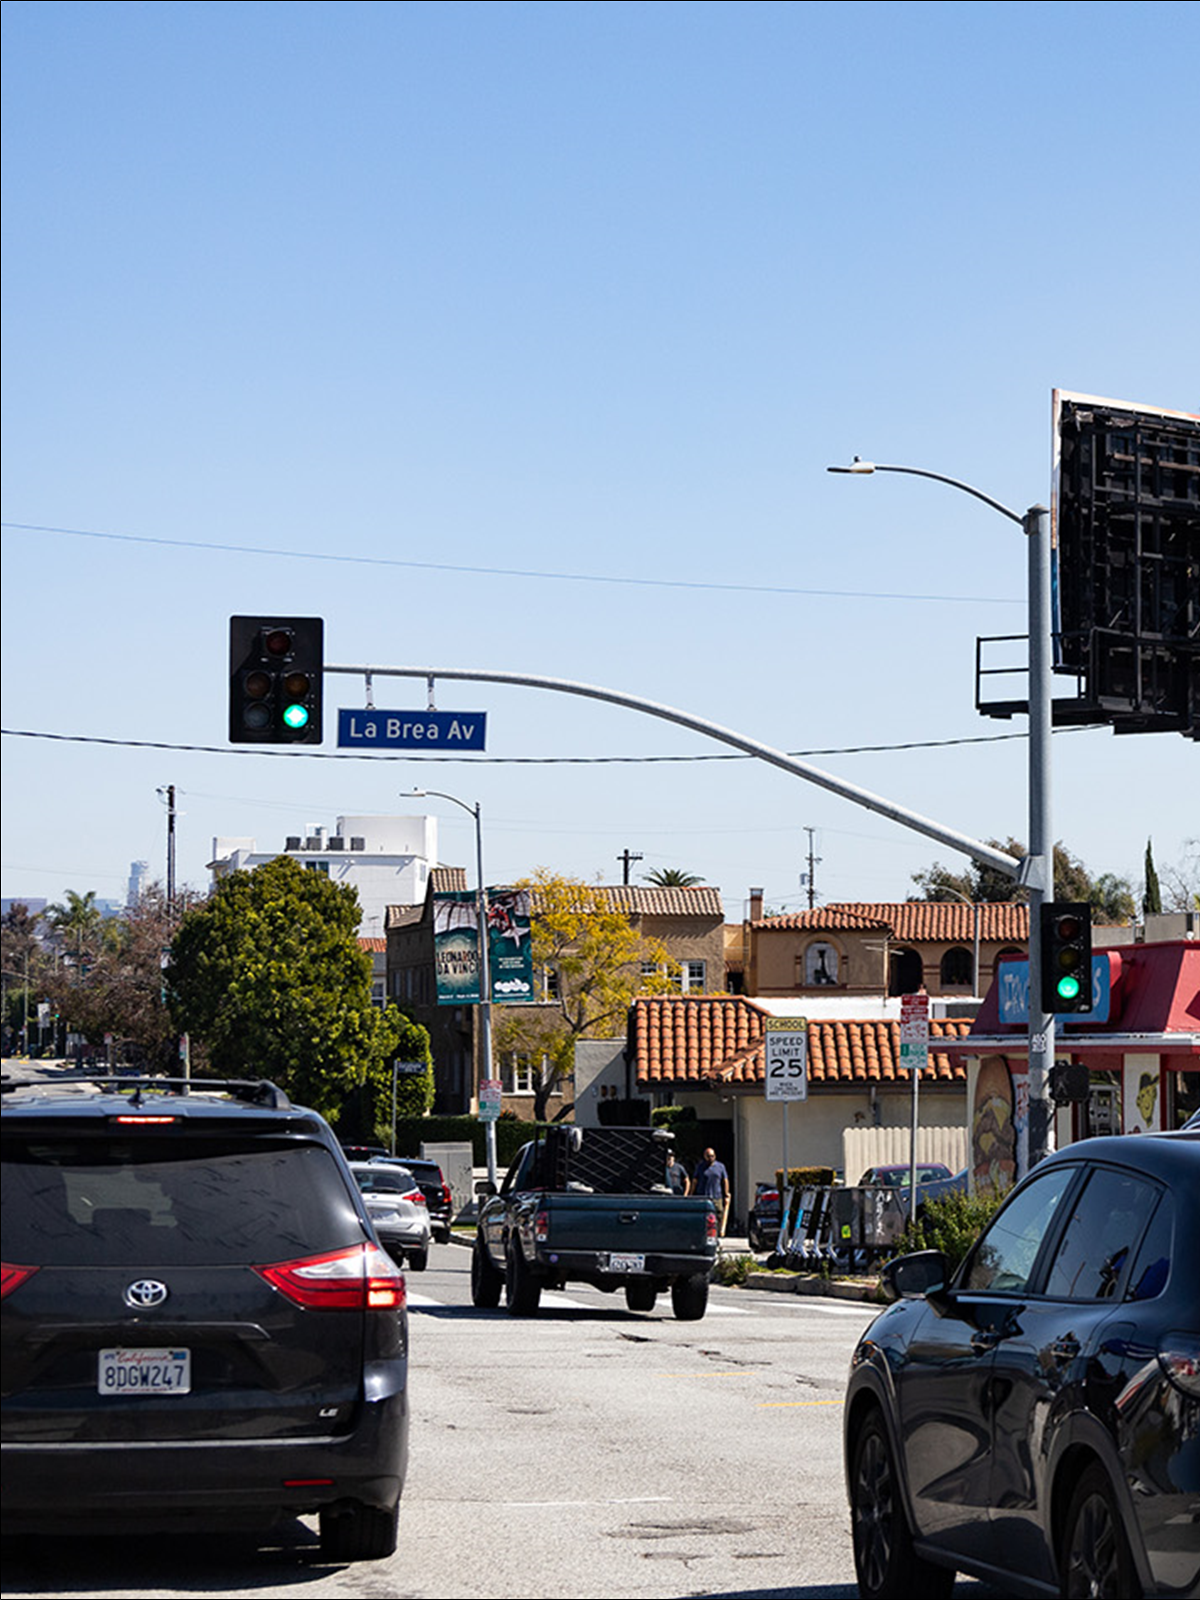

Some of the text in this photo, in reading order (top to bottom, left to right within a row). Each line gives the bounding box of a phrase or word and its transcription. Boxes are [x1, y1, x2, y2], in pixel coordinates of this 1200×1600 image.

[350, 717, 474, 740] La Brea Av
[436, 963, 450, 975] DA
[768, 1020, 804, 1030] SCHOOL
[769, 1036, 804, 1046] SPEED
[772, 1047, 800, 1057] LIMIT
[770, 1058, 803, 1078] 25
[118, 1352, 168, 1365] California
[105, 1365, 184, 1387] 8DGW247
[319, 1408, 338, 1417] LE
